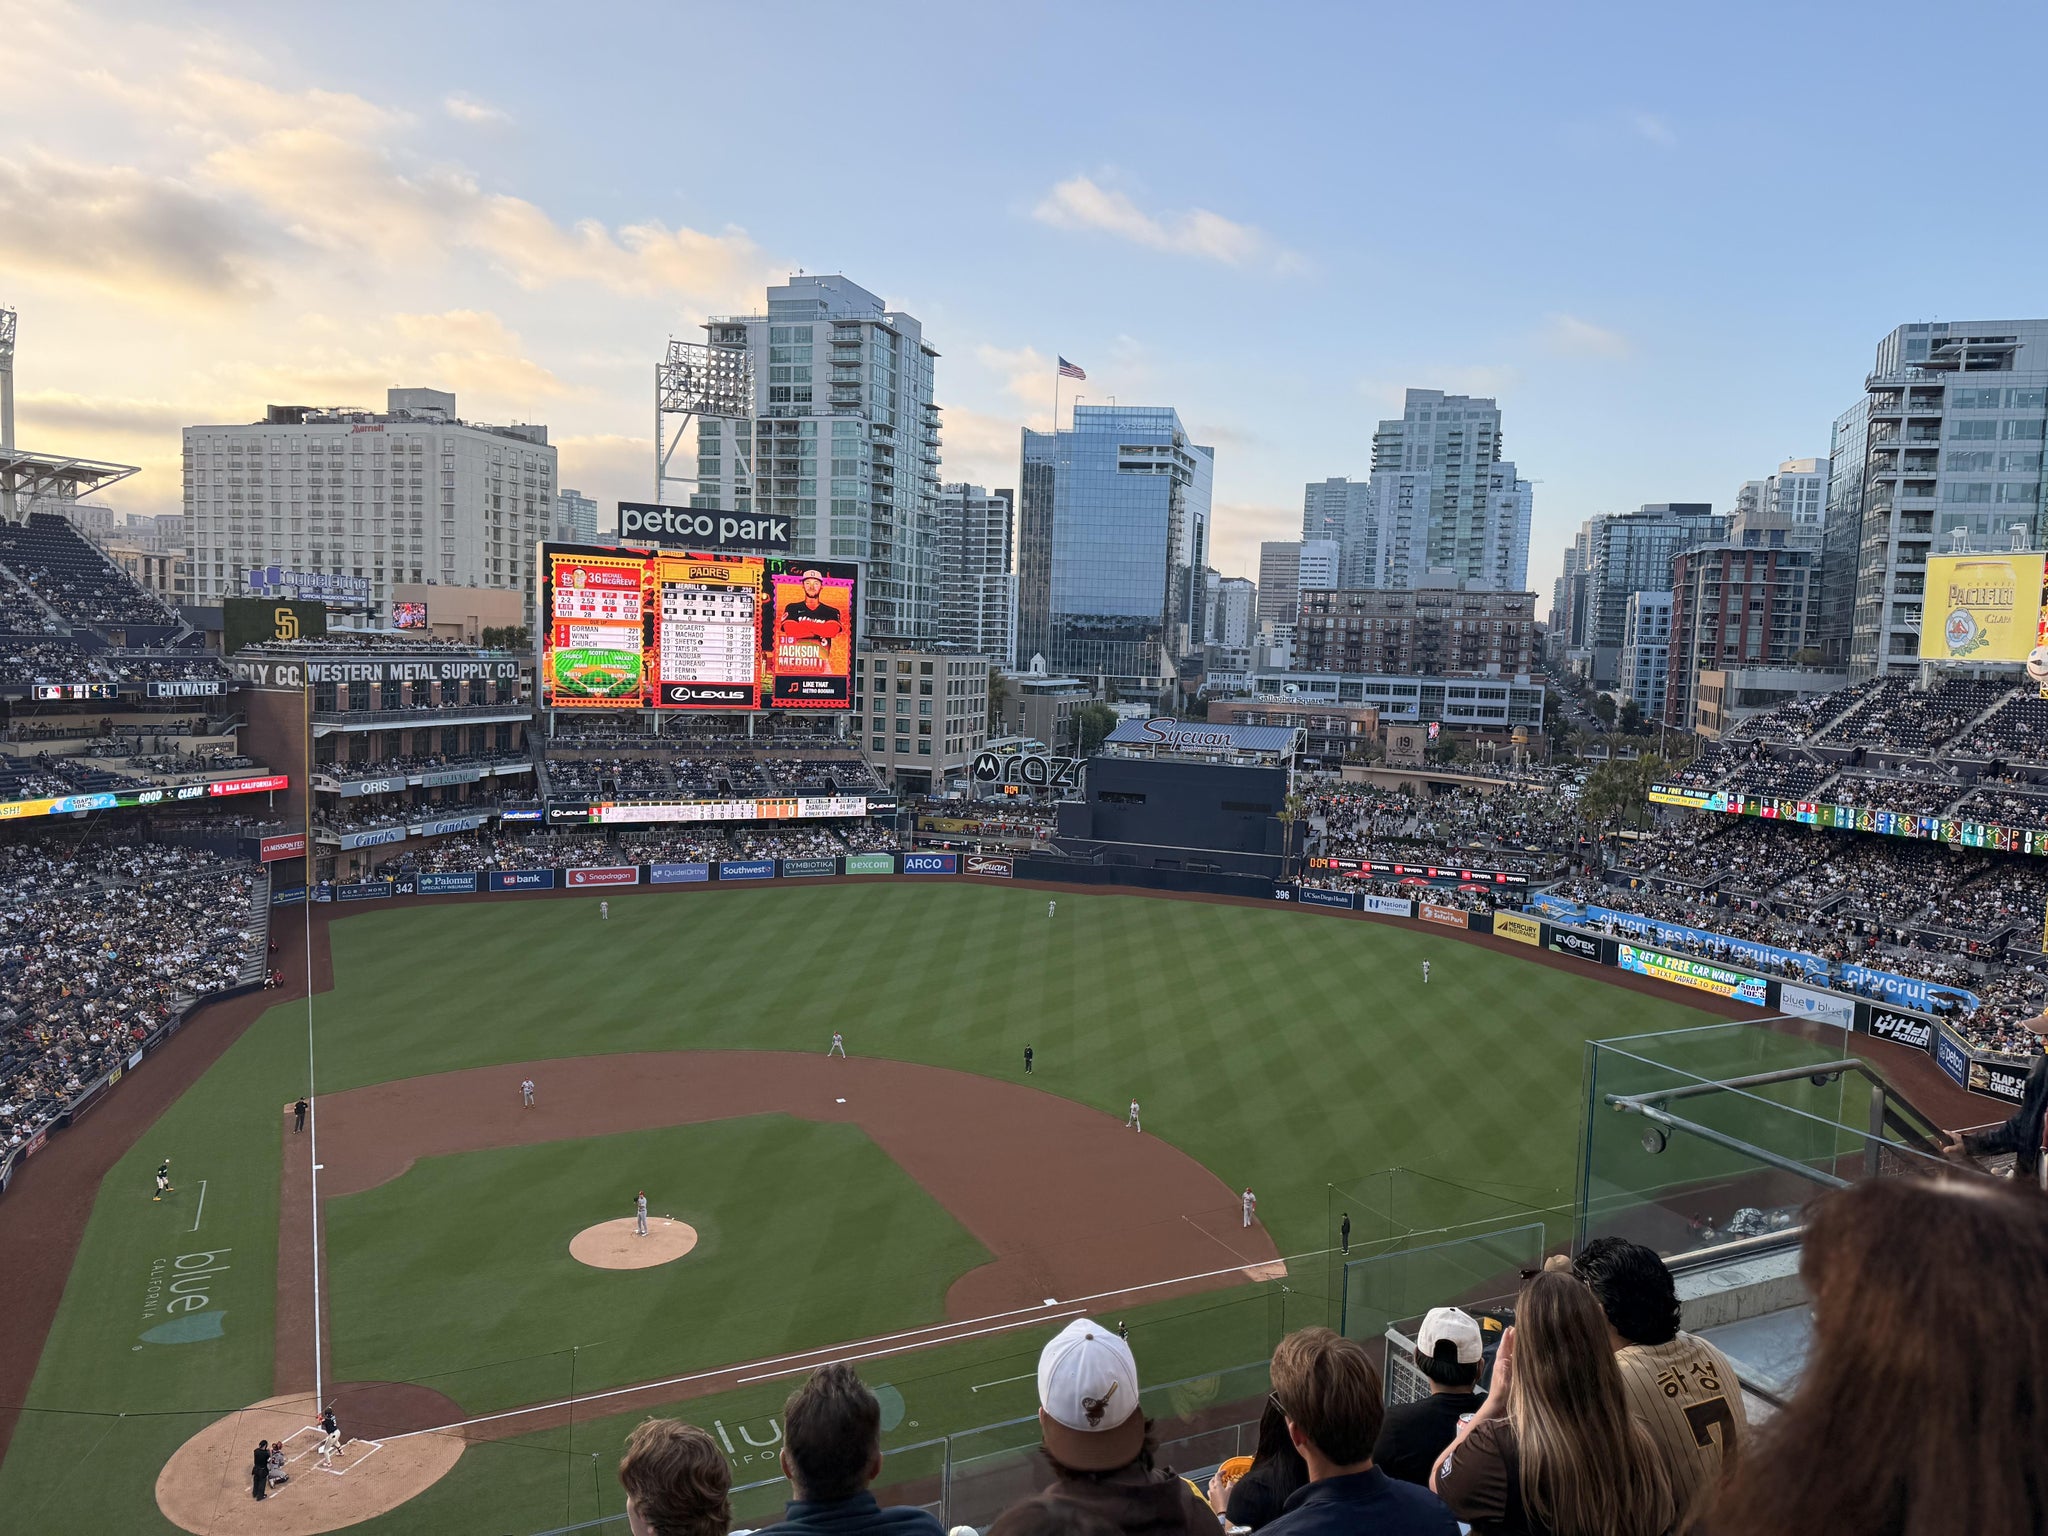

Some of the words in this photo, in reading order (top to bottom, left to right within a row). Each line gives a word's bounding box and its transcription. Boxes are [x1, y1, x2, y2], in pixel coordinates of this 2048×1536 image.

[352, 424, 384, 434] Marriott
[622, 507, 713, 536] petco
[720, 517, 787, 544] park
[588, 572, 601, 583] 36
[690, 567, 729, 580] PADRES
[283, 570, 369, 590] QuidelOrtho
[602, 578, 636, 586] McGREEVY
[1948, 584, 2015, 607] PACIFICO
[779, 645, 819, 657] JACKSON
[276, 666, 304, 687] CO.
[307, 661, 382, 682] WESTERN
[390, 662, 437, 681] METAL
[441, 662, 492, 680] SUPPLY
[497, 662, 518, 679] CO.
[158, 683, 219, 696] CUTWATER
[691, 690, 744, 699] LEXUS
[1258, 694, 1294, 703] Gallagher
[1140, 717, 1234, 751] Sycuan
[1400, 736, 1410, 747] 19
[1004, 755, 1088, 788] razr
[241, 781, 272, 790] CALIFORNIA
[361, 781, 390, 794] ORIS
[1004, 785, 1018, 794] 0:09
[139, 791, 162, 803] GOOD
[178, 786, 203, 799] CLEAN
[1737, 795, 1744, 804] 10
[788, 805, 794, 817] 0
[1738, 804, 1743, 813] 0
[1848, 819, 1854, 828] 6
[1890, 814, 1895, 824] 3
[434, 819, 470, 834] Canel's
[1933, 820, 1938, 830] 0
[1932, 830, 1938, 840] 0
[1978, 826, 1984, 836] 0
[2026, 832, 2032, 841] 0
[354, 831, 395, 847] Canel's
[1977, 837, 1983, 846] 0
[316, 846, 331, 857] 336
[2024, 843, 2031, 852] 0
[906, 858, 942, 870] ARCO
[967, 858, 1007, 872] Sycuan
[1310, 858, 1328, 868] 0:09
[589, 872, 630, 880] Snapdragon
[664, 869, 705, 877] QuidelOrtho
[723, 866, 765, 875] Southwest
[434, 876, 473, 885] Palomar
[516, 874, 540, 883] bank
[395, 883, 413, 894] 342
[1275, 890, 1289, 899] 396
[1320, 894, 1333, 902] Diego
[1381, 900, 1408, 909] National
[1450, 916, 1463, 924] Park
[1508, 927, 1536, 938] INSURANCE
[1509, 921, 1536, 933] MERCURY
[1556, 934, 1595, 951] EVOTEK
[1640, 951, 1655, 962] GET
[1656, 956, 1662, 965] A
[1665, 957, 1690, 972] FREE
[1692, 964, 1709, 977] CAR
[1711, 969, 1736, 984] WASH
[1657, 969, 1671, 978] TEXT
[1674, 974, 1697, 985] PADRES
[1711, 984, 1731, 994] 94333
[1740, 981, 1766, 994] SOAPY
[1782, 992, 1805, 1006] blue
[1946, 1045, 1963, 1071] petco
[1991, 1072, 2015, 1085] SLAP
[1991, 1083, 2019, 1098] CHEESE
[166, 1248, 232, 1313] blue
[142, 1258, 166, 1320] CALIFORNIA
[1657, 1361, 1720, 1398] 하성
[714, 1419, 783, 1454] lu
[1682, 1394, 1737, 1472] 7
